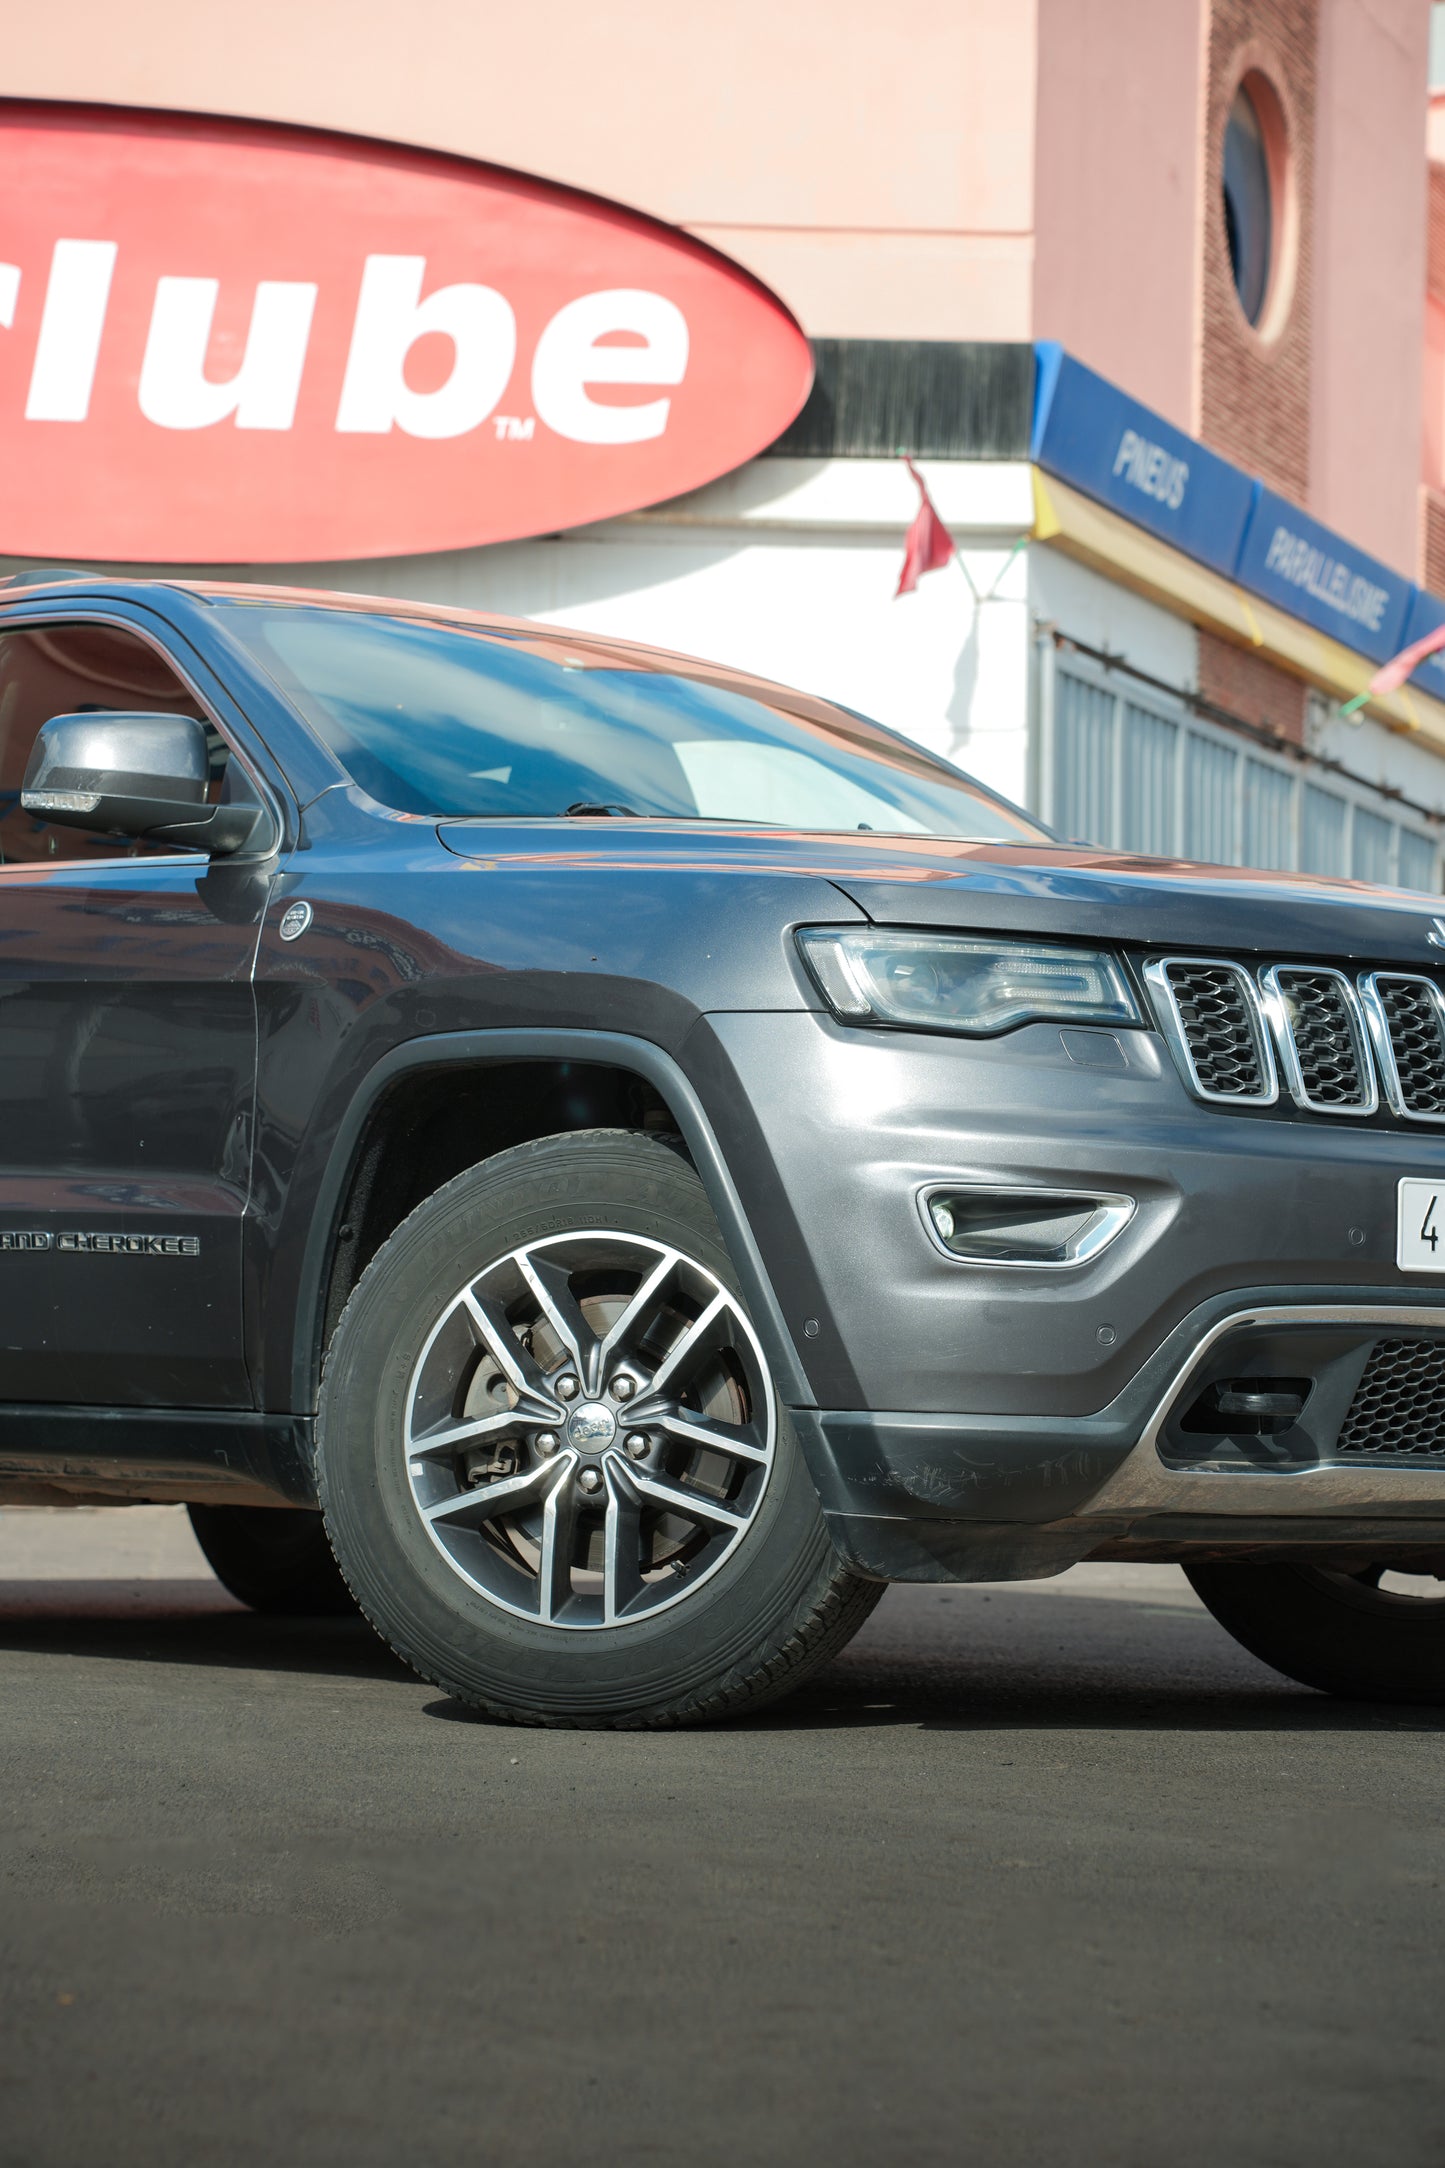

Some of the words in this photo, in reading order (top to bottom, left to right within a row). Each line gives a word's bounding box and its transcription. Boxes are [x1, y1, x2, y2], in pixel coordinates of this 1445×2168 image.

[1112, 428, 1190, 511] PNEUS
[1263, 526, 1389, 633] PARALLELISME
[57, 1232, 200, 1256] CHEROKEE
[1420, 1195, 1438, 1252] 4
